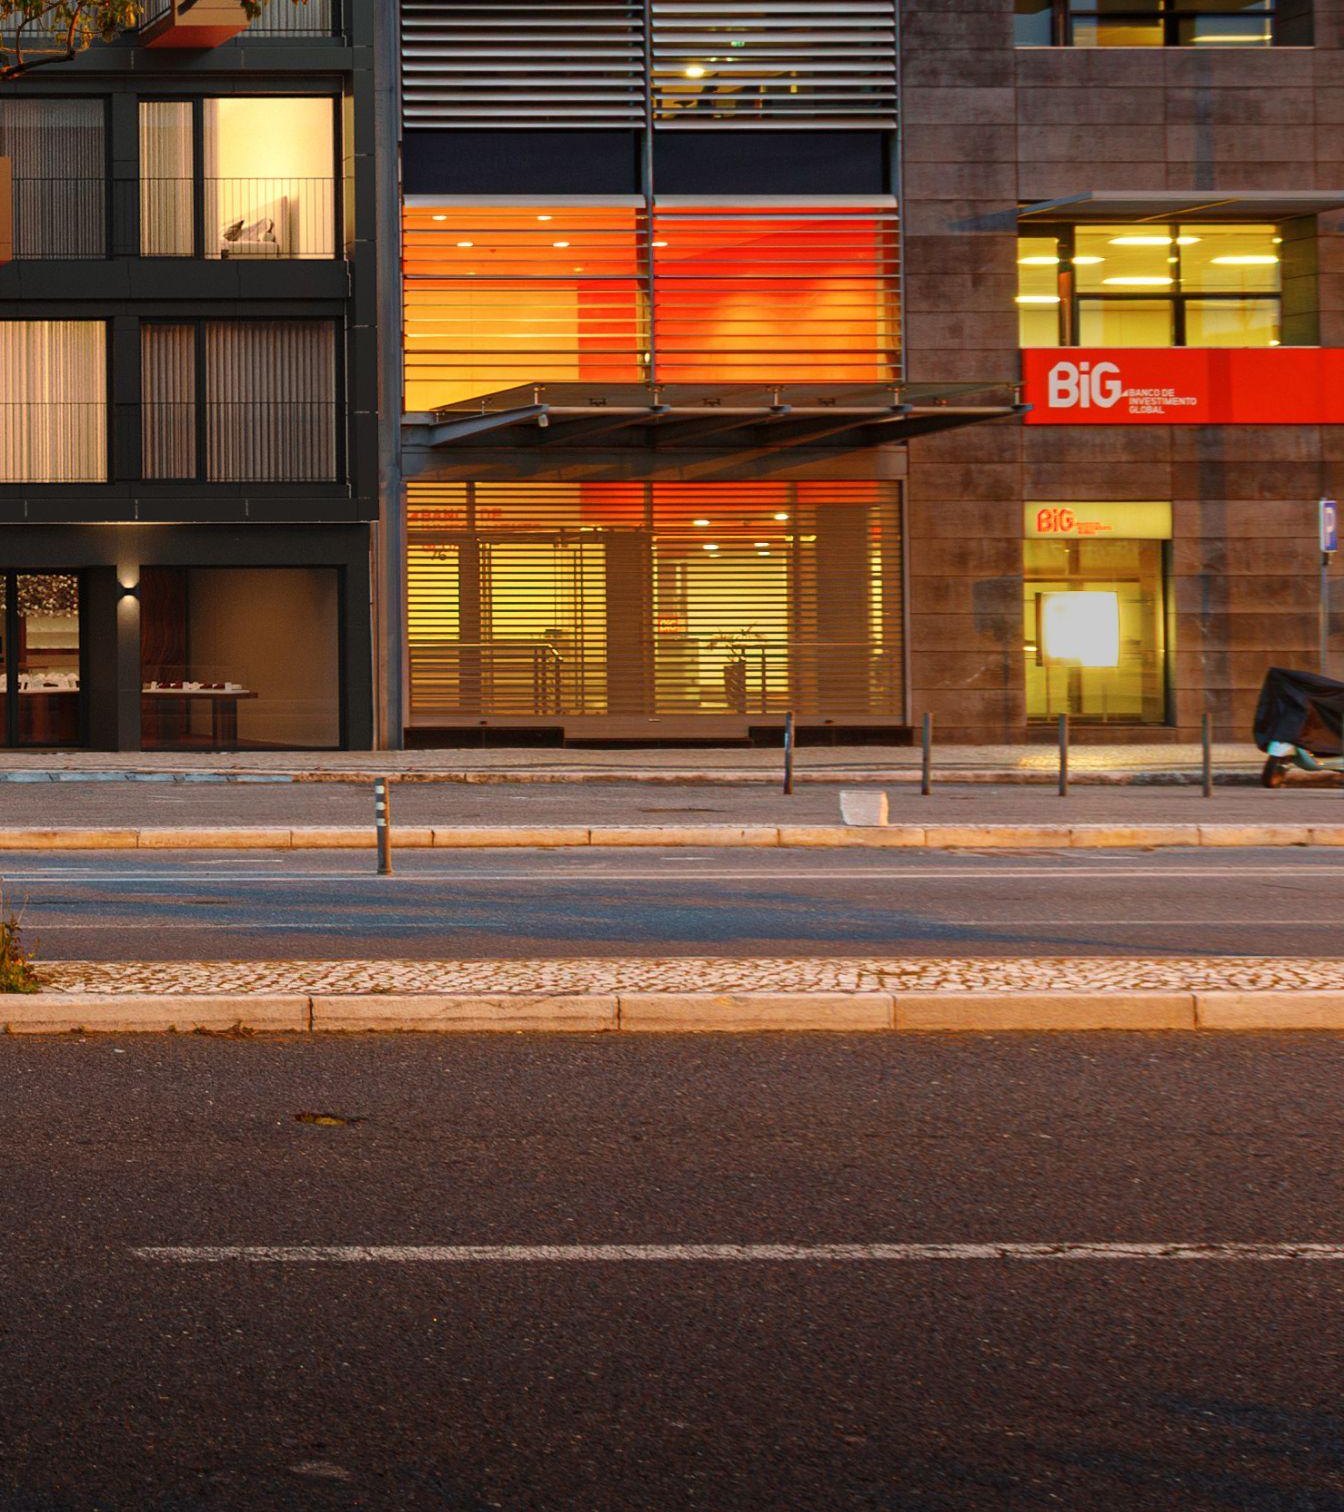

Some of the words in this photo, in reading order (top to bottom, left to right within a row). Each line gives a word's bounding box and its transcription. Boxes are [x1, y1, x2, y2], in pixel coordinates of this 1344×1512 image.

[1129, 388, 1160, 397] BANCO
[1161, 388, 1176, 397] DE
[1129, 397, 1198, 406] INVESTIMENTO
[1129, 406, 1166, 414] GLOBAL
